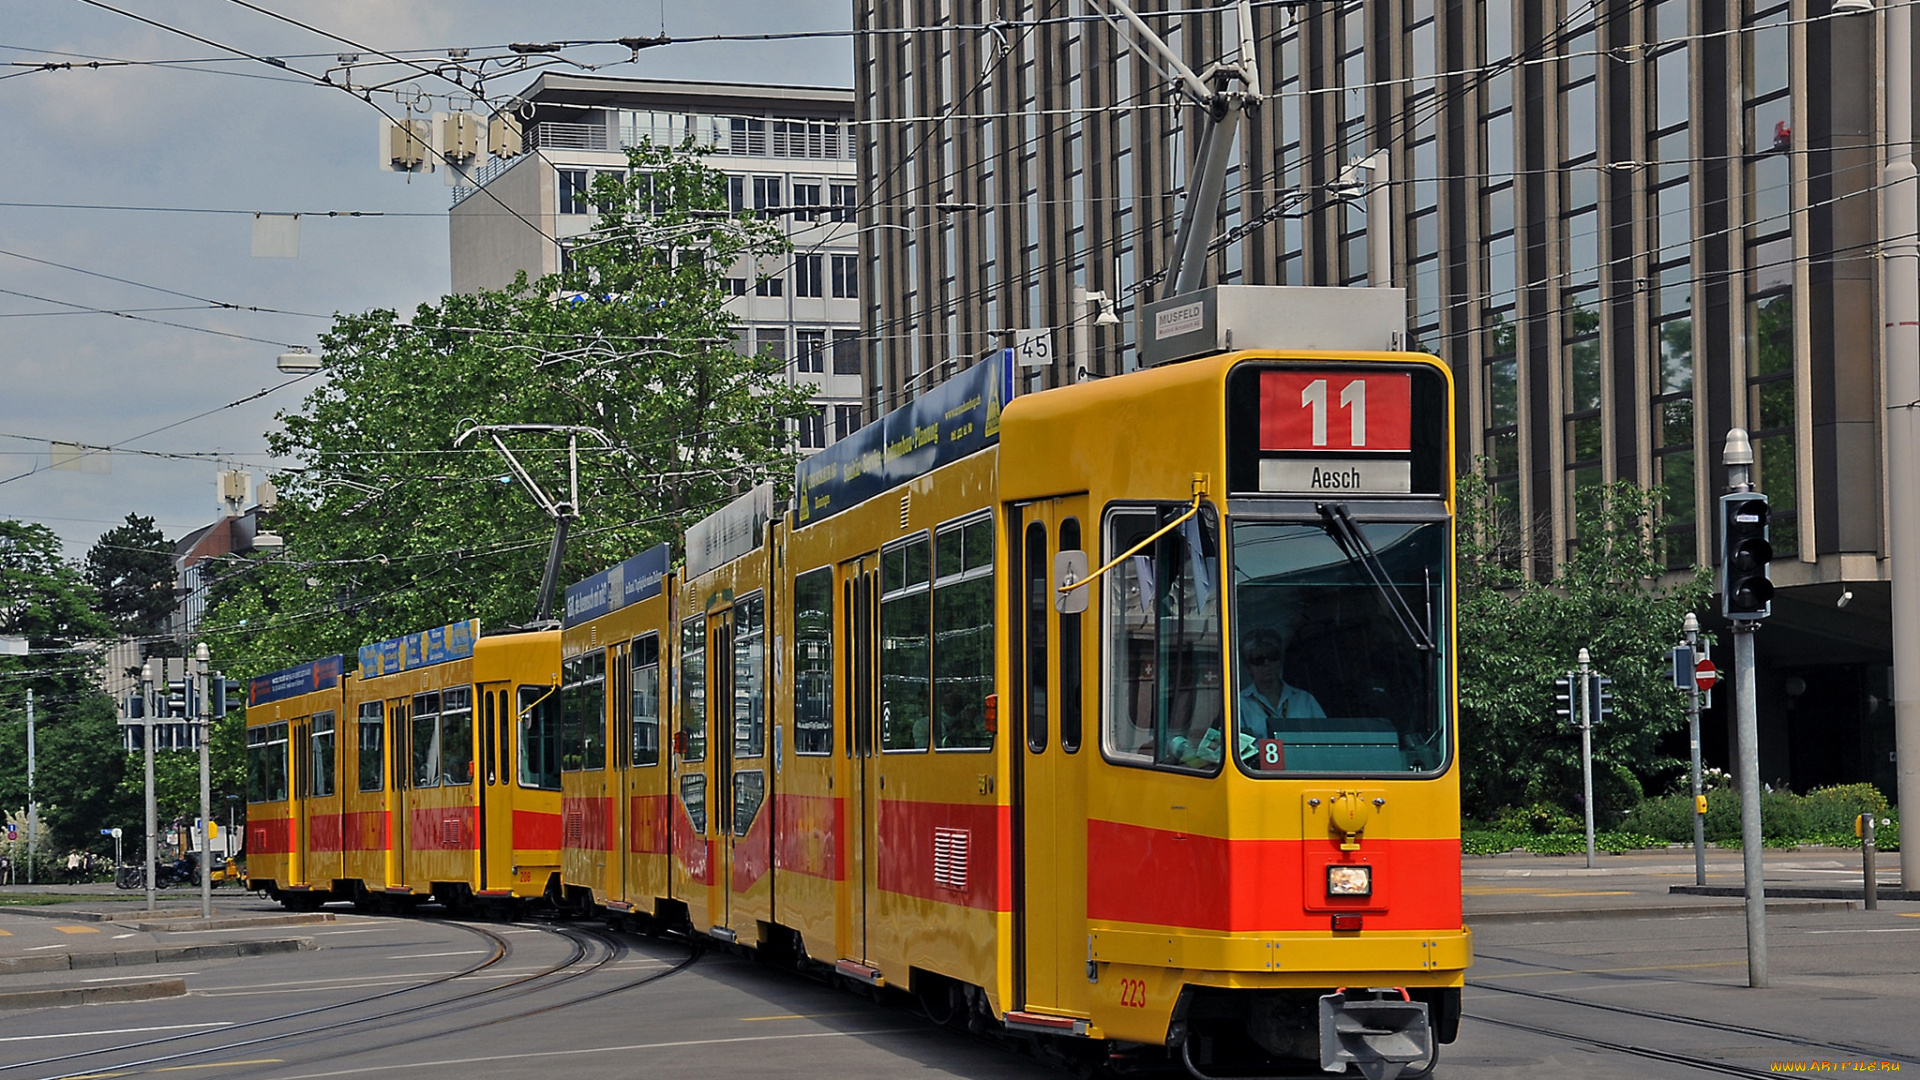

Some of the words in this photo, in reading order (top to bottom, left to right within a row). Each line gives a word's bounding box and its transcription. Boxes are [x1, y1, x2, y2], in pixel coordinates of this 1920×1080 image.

[1159, 306, 1200, 326] MUSFELD
[1022, 335, 1048, 358] 45
[1301, 379, 1367, 447] 11
[1311, 467, 1361, 489] Aesch
[1265, 742, 1280, 764] 8
[1121, 978, 1146, 1008] 223
